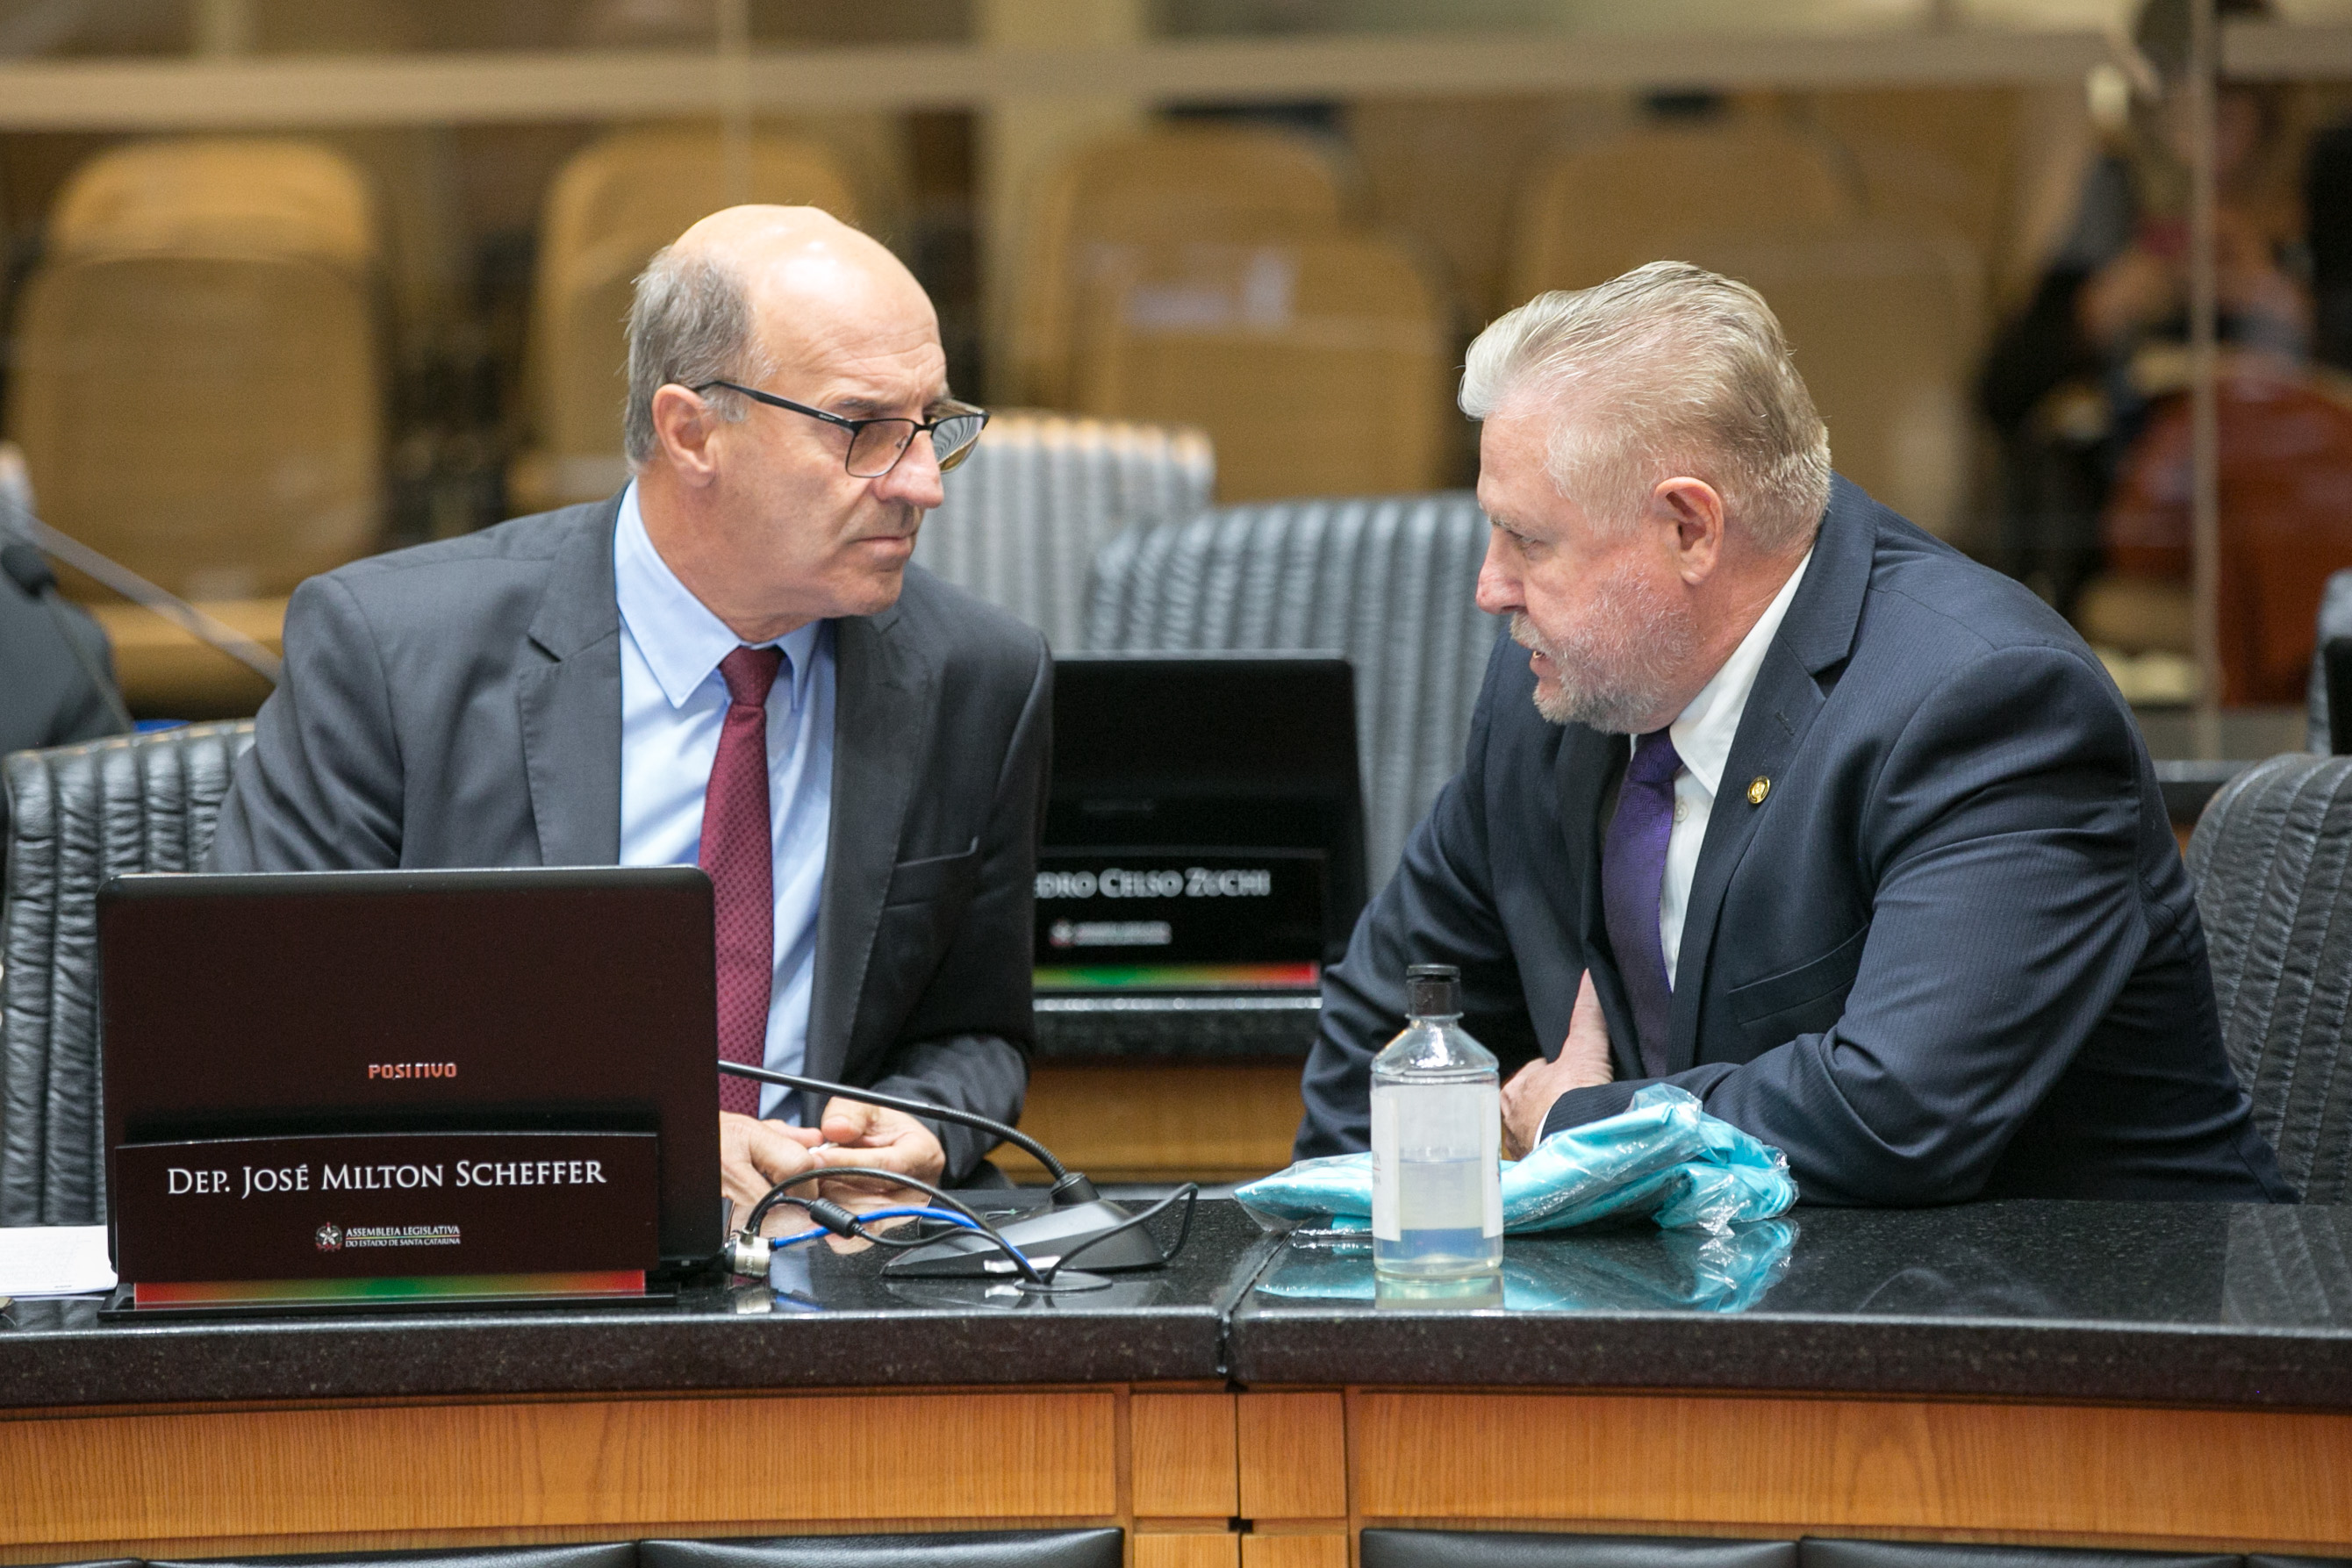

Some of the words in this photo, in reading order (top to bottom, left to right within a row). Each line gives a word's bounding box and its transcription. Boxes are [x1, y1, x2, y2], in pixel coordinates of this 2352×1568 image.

[368, 1063, 457, 1079] POSITIVO
[167, 1168, 231, 1195] DEP.
[241, 1163, 310, 1199] JOSÉ
[321, 1163, 443, 1190] MILTON
[455, 1160, 607, 1187] SCHEFFER
[346, 1228, 401, 1237] ASSEMBLEIA
[403, 1226, 461, 1236] LEGISLATIVA
[424, 1237, 461, 1246] CATARINA
